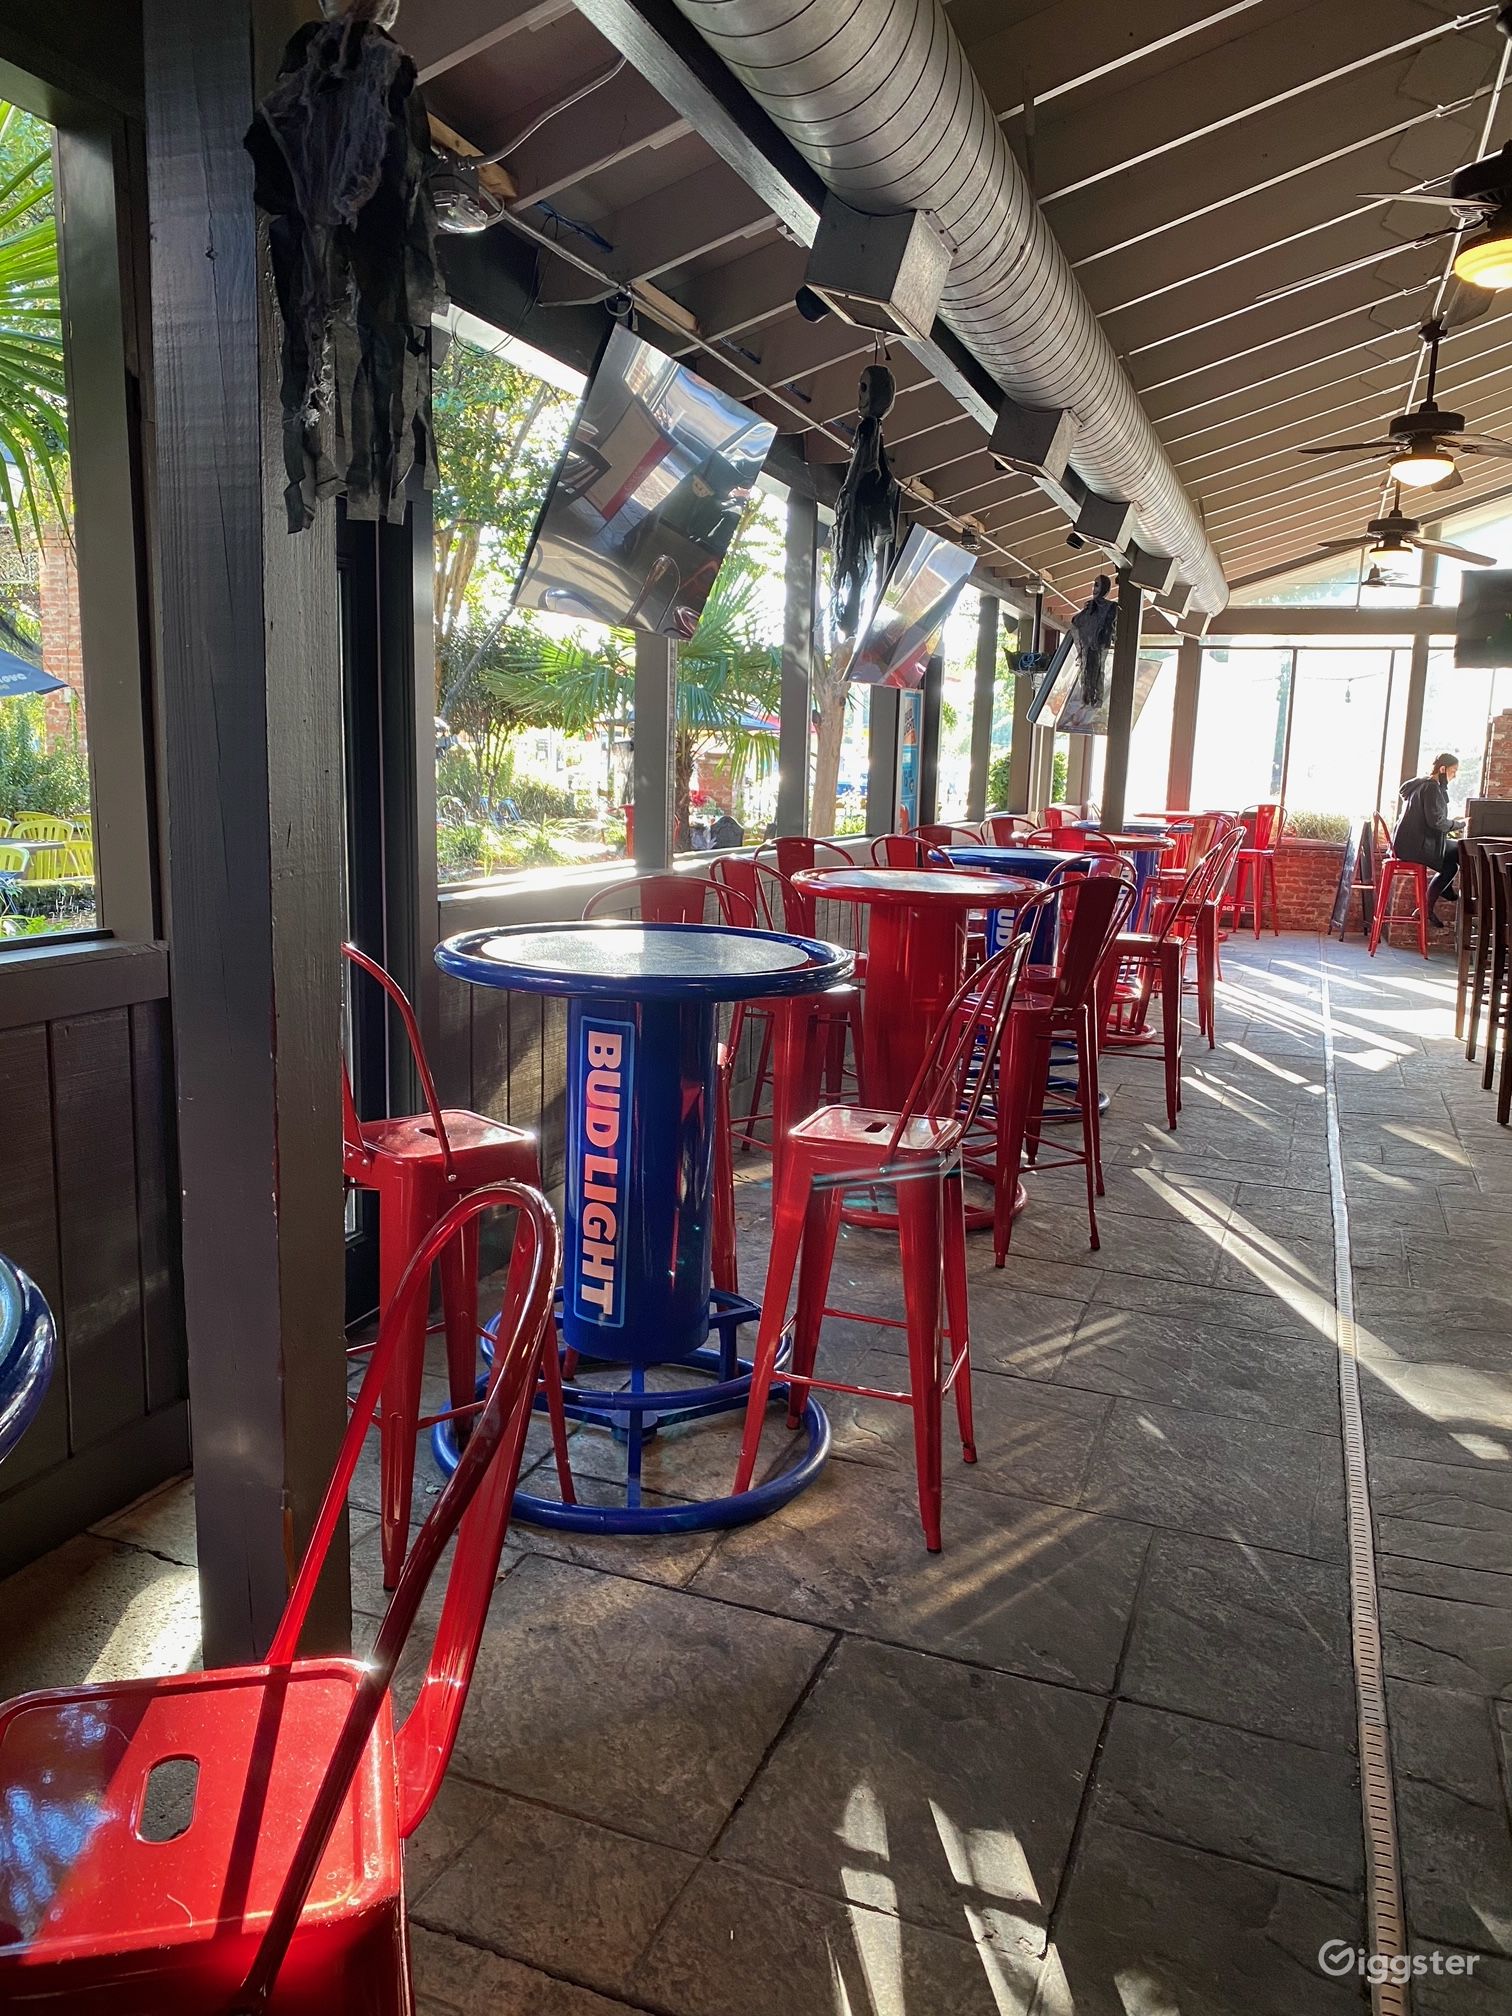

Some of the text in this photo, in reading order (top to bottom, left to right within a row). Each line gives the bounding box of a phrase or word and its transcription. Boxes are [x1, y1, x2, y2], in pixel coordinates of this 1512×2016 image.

[996, 908, 1015, 947] UD
[581, 1030, 622, 1315] BUD LIGHT
